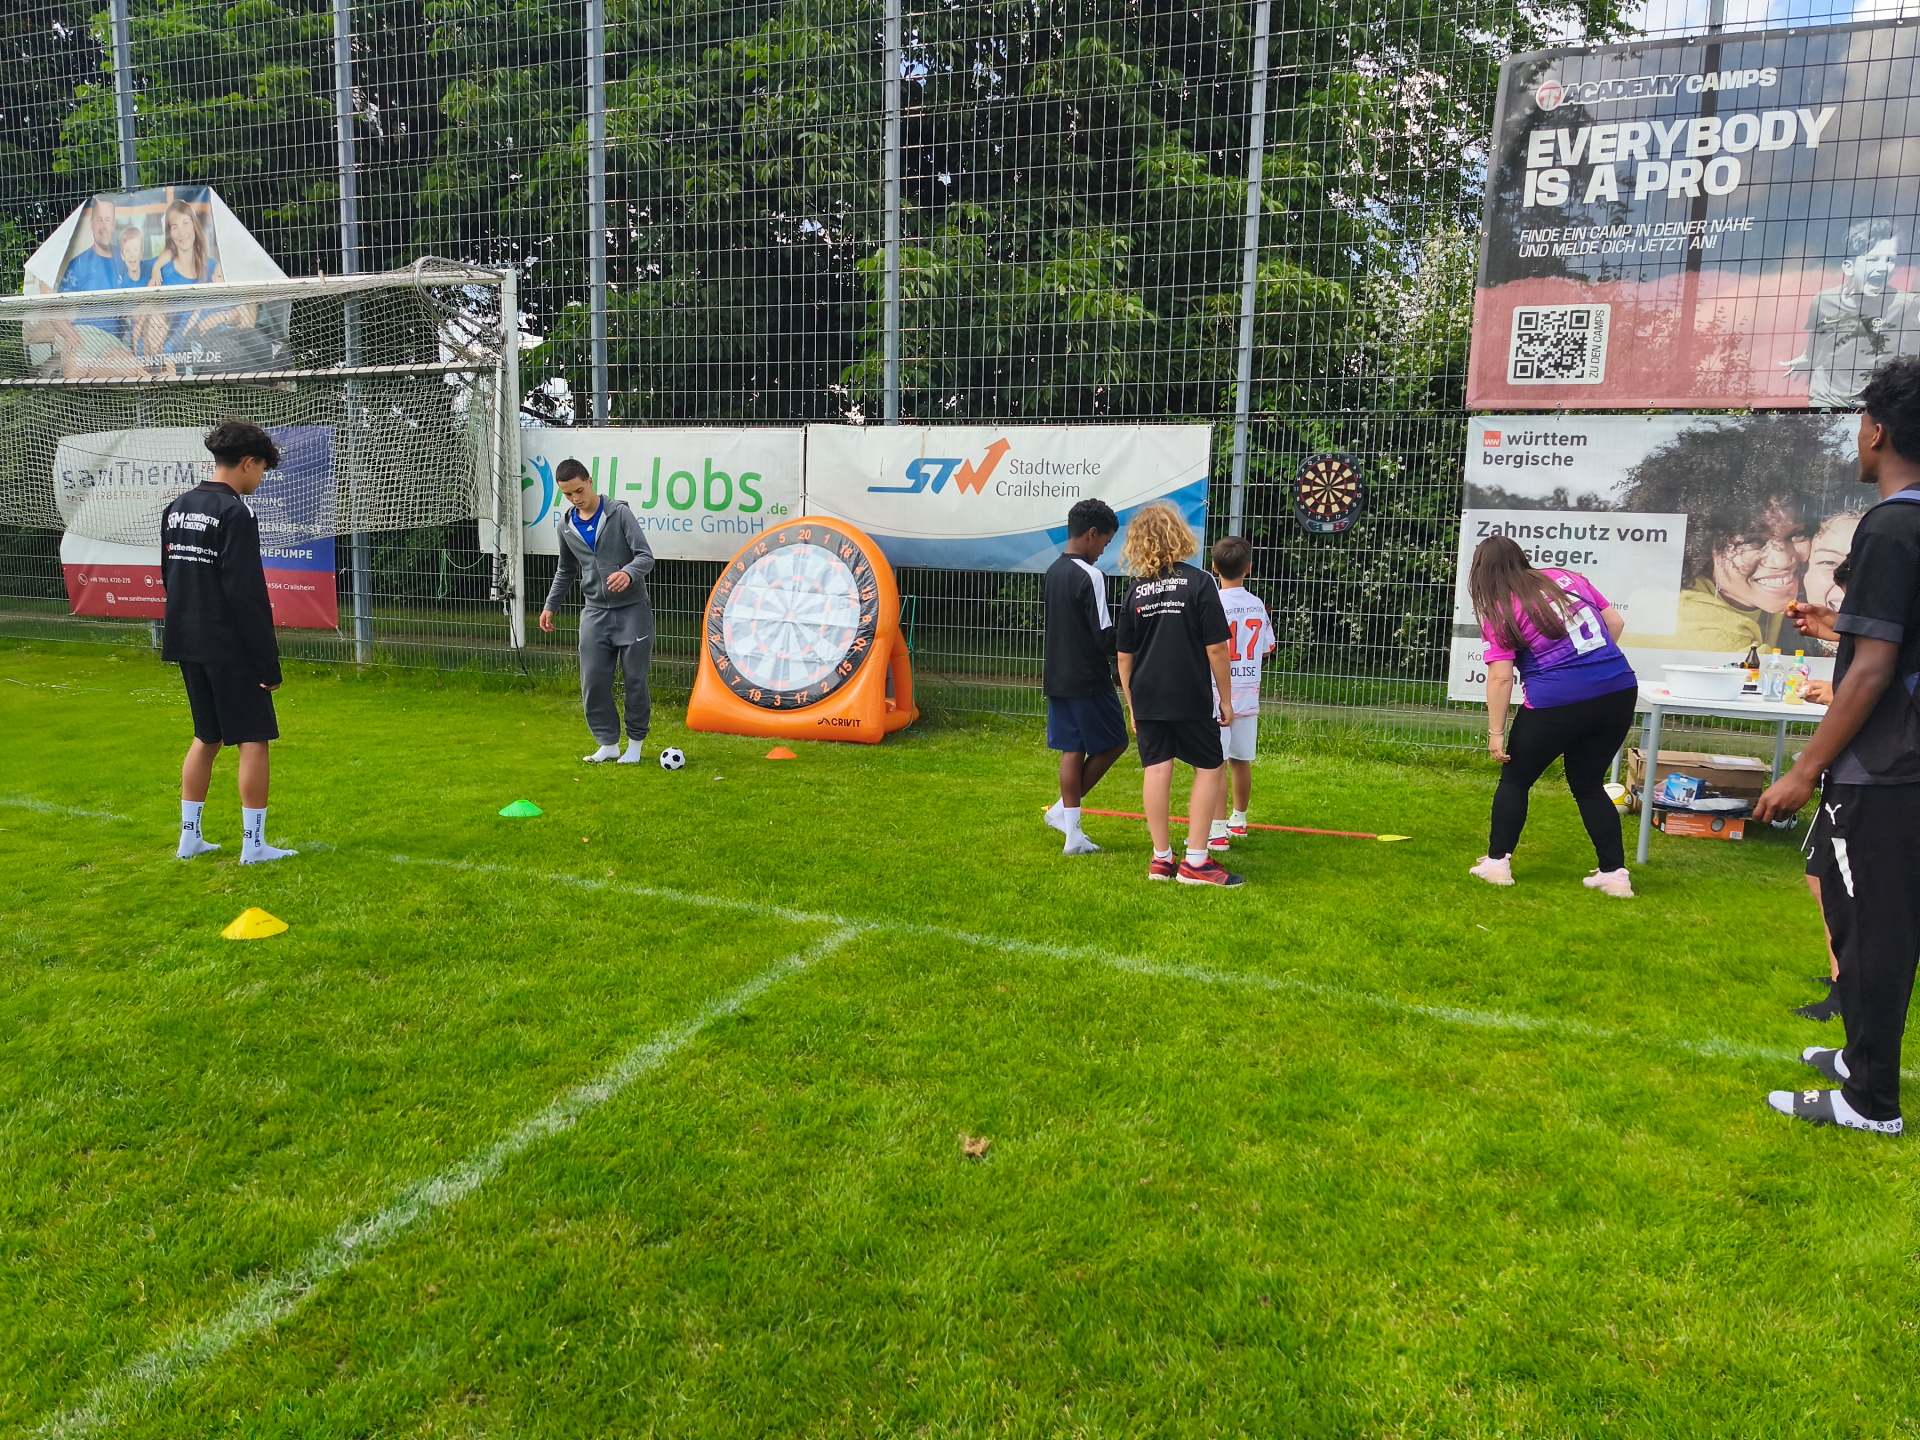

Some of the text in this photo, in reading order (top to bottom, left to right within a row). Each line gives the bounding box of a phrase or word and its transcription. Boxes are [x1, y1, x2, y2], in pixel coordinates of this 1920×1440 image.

[1562, 74, 1685, 105] ACADEMY
[1686, 67, 1777, 94] CAMPS
[1526, 106, 1837, 168] EVERYBODY
[1522, 156, 1742, 208] IS A PRO
[1519, 216, 1755, 244] FINDE EIN CAMP IN DEINER NÄHE
[1518, 234, 1718, 258] UND MELDE DICH JETZT AN!
[1589, 309, 1605, 379] ZU DEN CAMPS
[1507, 430, 1588, 447] württem
[1009, 458, 1101, 476] Stadtwerke
[1482, 451, 1575, 469] bergische
[995, 480, 1081, 498] Crailsheim
[700, 515, 765, 535] GmbH
[1476, 520, 1668, 543] Zahnschutz vom
[779, 532, 786, 544] 5
[798, 529, 812, 541] 20
[824, 534, 831, 545] 1
[260, 548, 313, 560] MEPUMPE
[753, 542, 768, 556] 12
[839, 544, 853, 560] 18
[1524, 544, 1598, 567] sieger.
[736, 561, 746, 571] 9
[855, 566, 865, 576] 4
[283, 583, 316, 591] Crailsheim
[720, 580, 733, 595] 14
[861, 585, 873, 601] 13
[1135, 582, 1155, 599] SGM
[711, 606, 723, 619] 11
[710, 634, 721, 643] 8
[853, 637, 868, 653] 10
[1229, 618, 1263, 662] 17
[716, 655, 729, 671] 16
[838, 661, 853, 677] 15
[1231, 666, 1256, 677] OLISE
[730, 675, 742, 687] 7
[820, 681, 830, 694] 2
[749, 687, 762, 702] 19
[773, 694, 781, 707] 3
[794, 690, 809, 704] 17
[831, 717, 862, 729] CRIVIT
